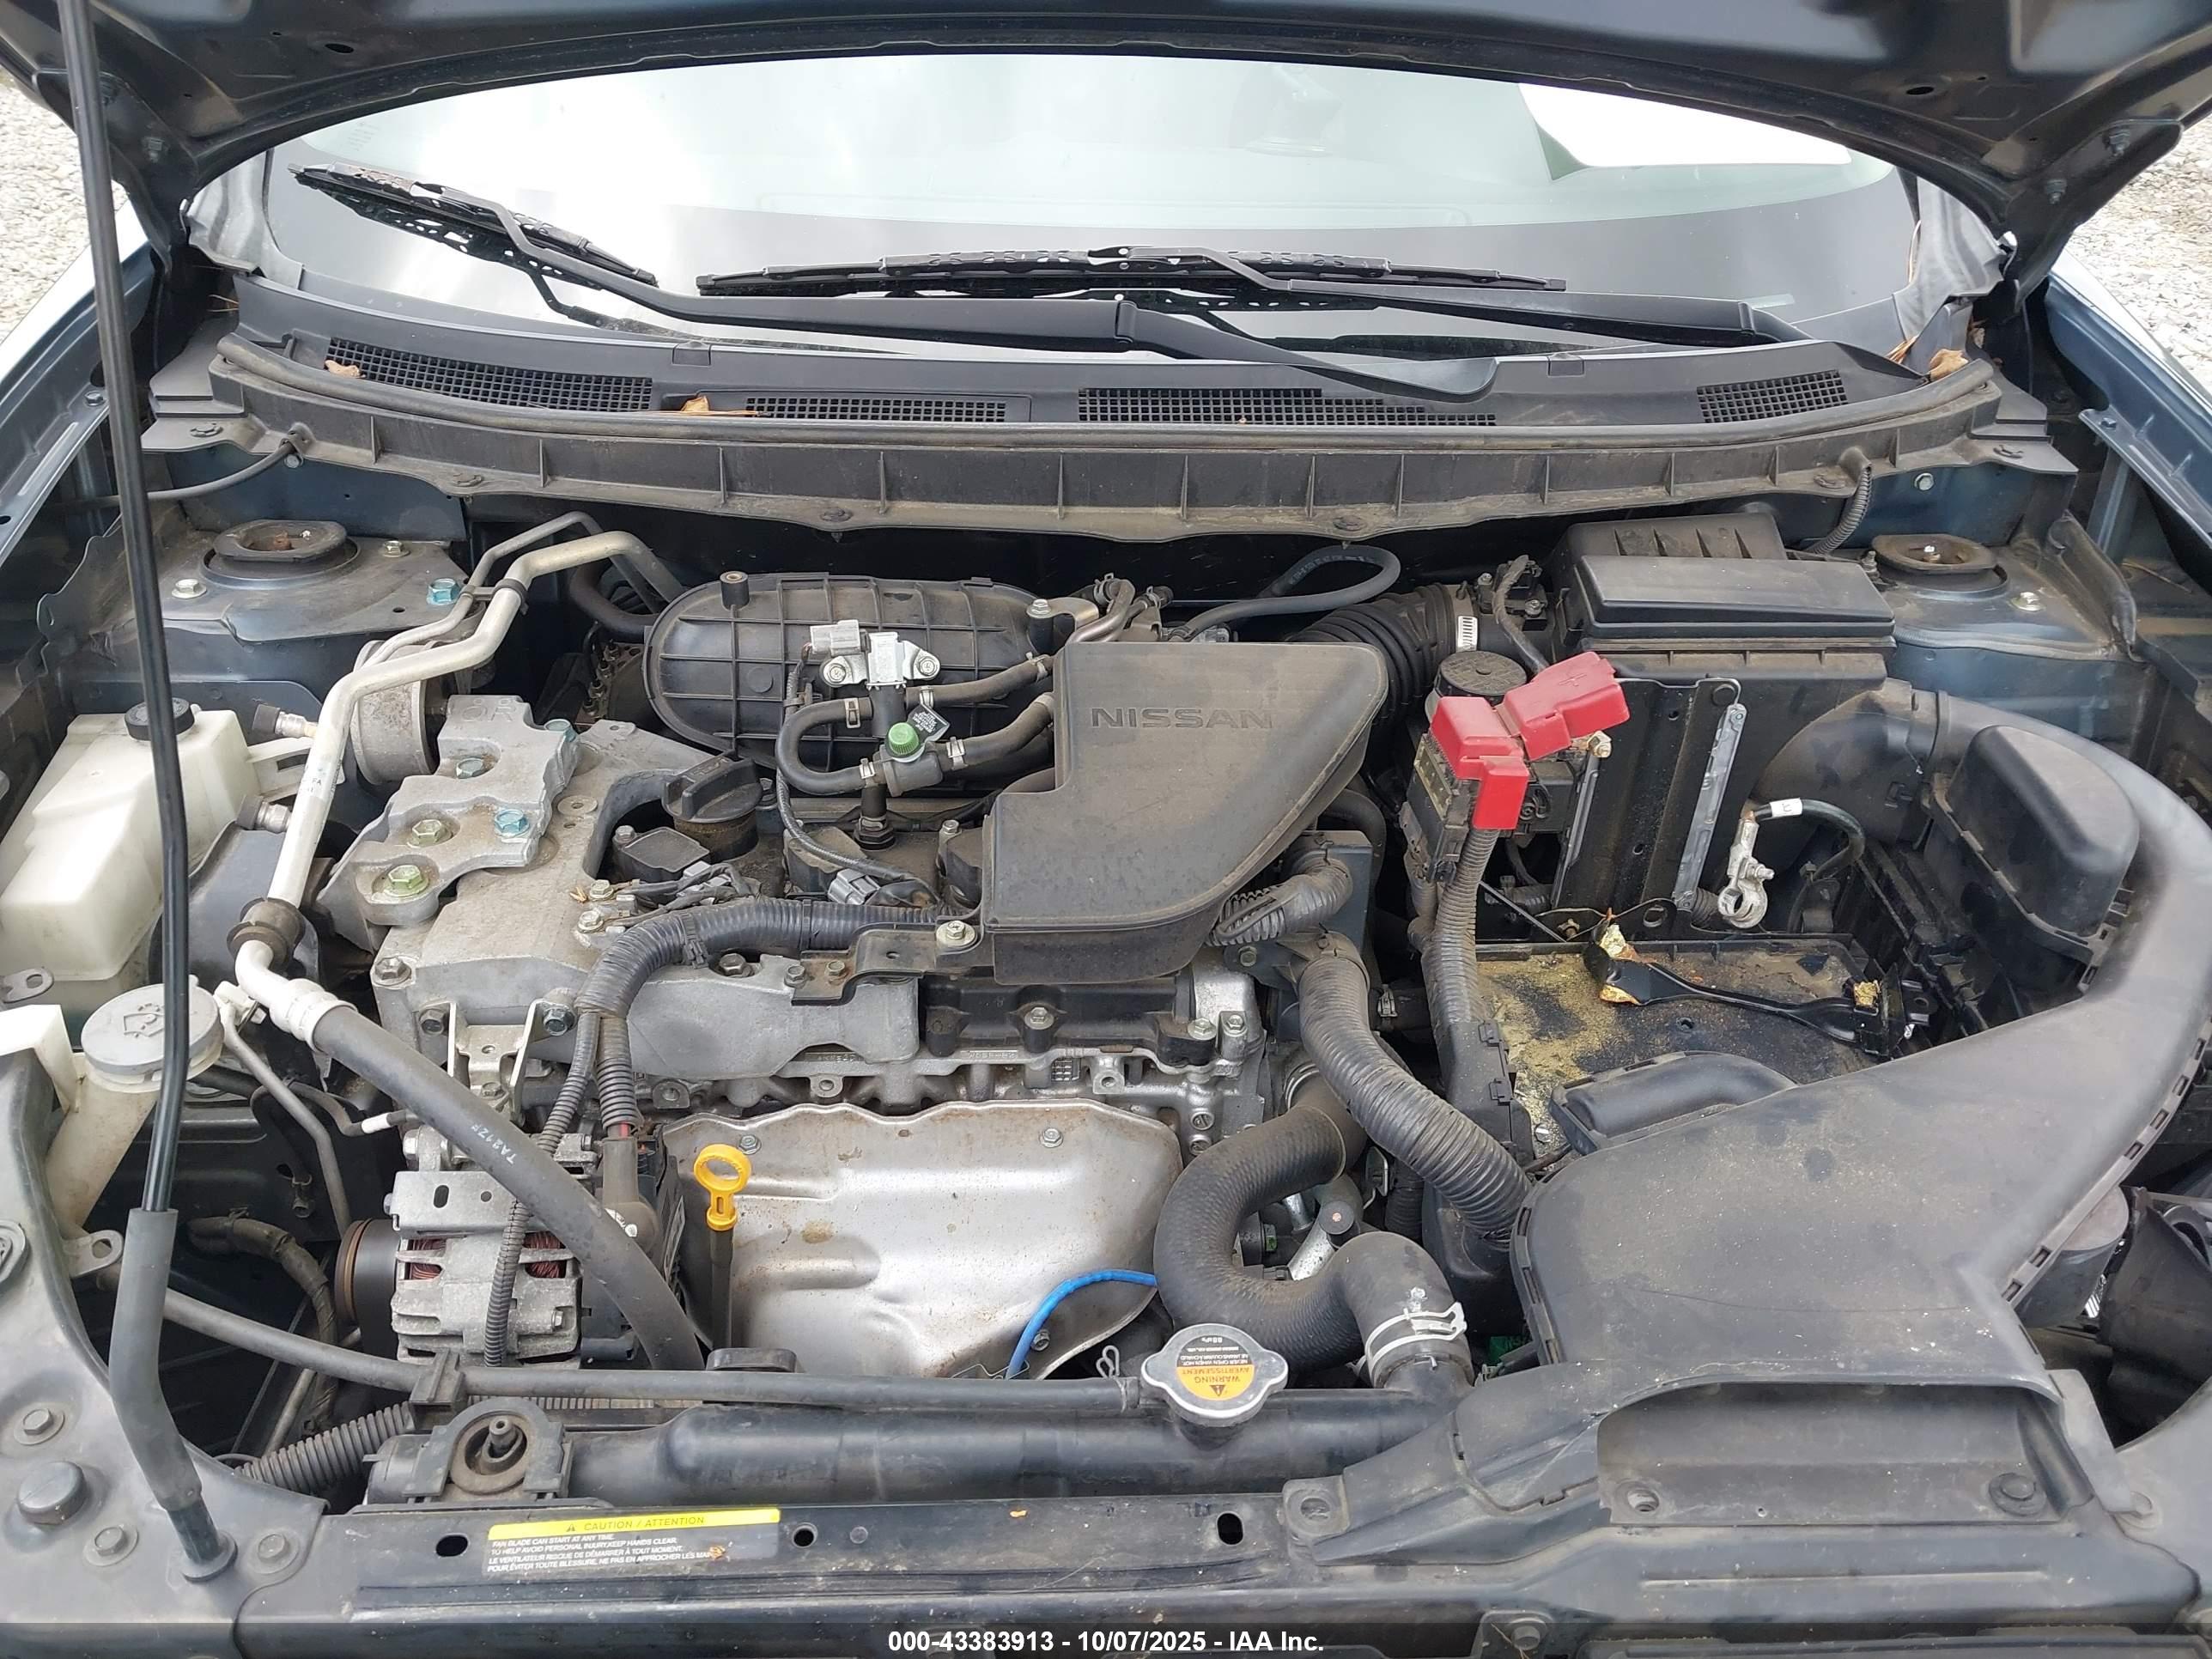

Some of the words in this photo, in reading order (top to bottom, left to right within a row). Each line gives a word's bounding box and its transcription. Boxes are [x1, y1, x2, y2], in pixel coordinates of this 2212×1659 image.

[1091, 708, 1273, 729] NISSAN
[584, 1521, 633, 1531] CAUTION
[645, 1516, 704, 1528] ATTENTION
[544, 1543, 583, 1553] PERSONAL
[627, 1538, 652, 1547] HANDS
[499, 1554, 545, 1564] VENTILATEUR
[546, 1552, 574, 1561] RISQUE
[585, 1548, 625, 1558] DÉMARRER
[509, 1562, 534, 1571] ÉVITER
[636, 1553, 681, 1563] APPROCHER
